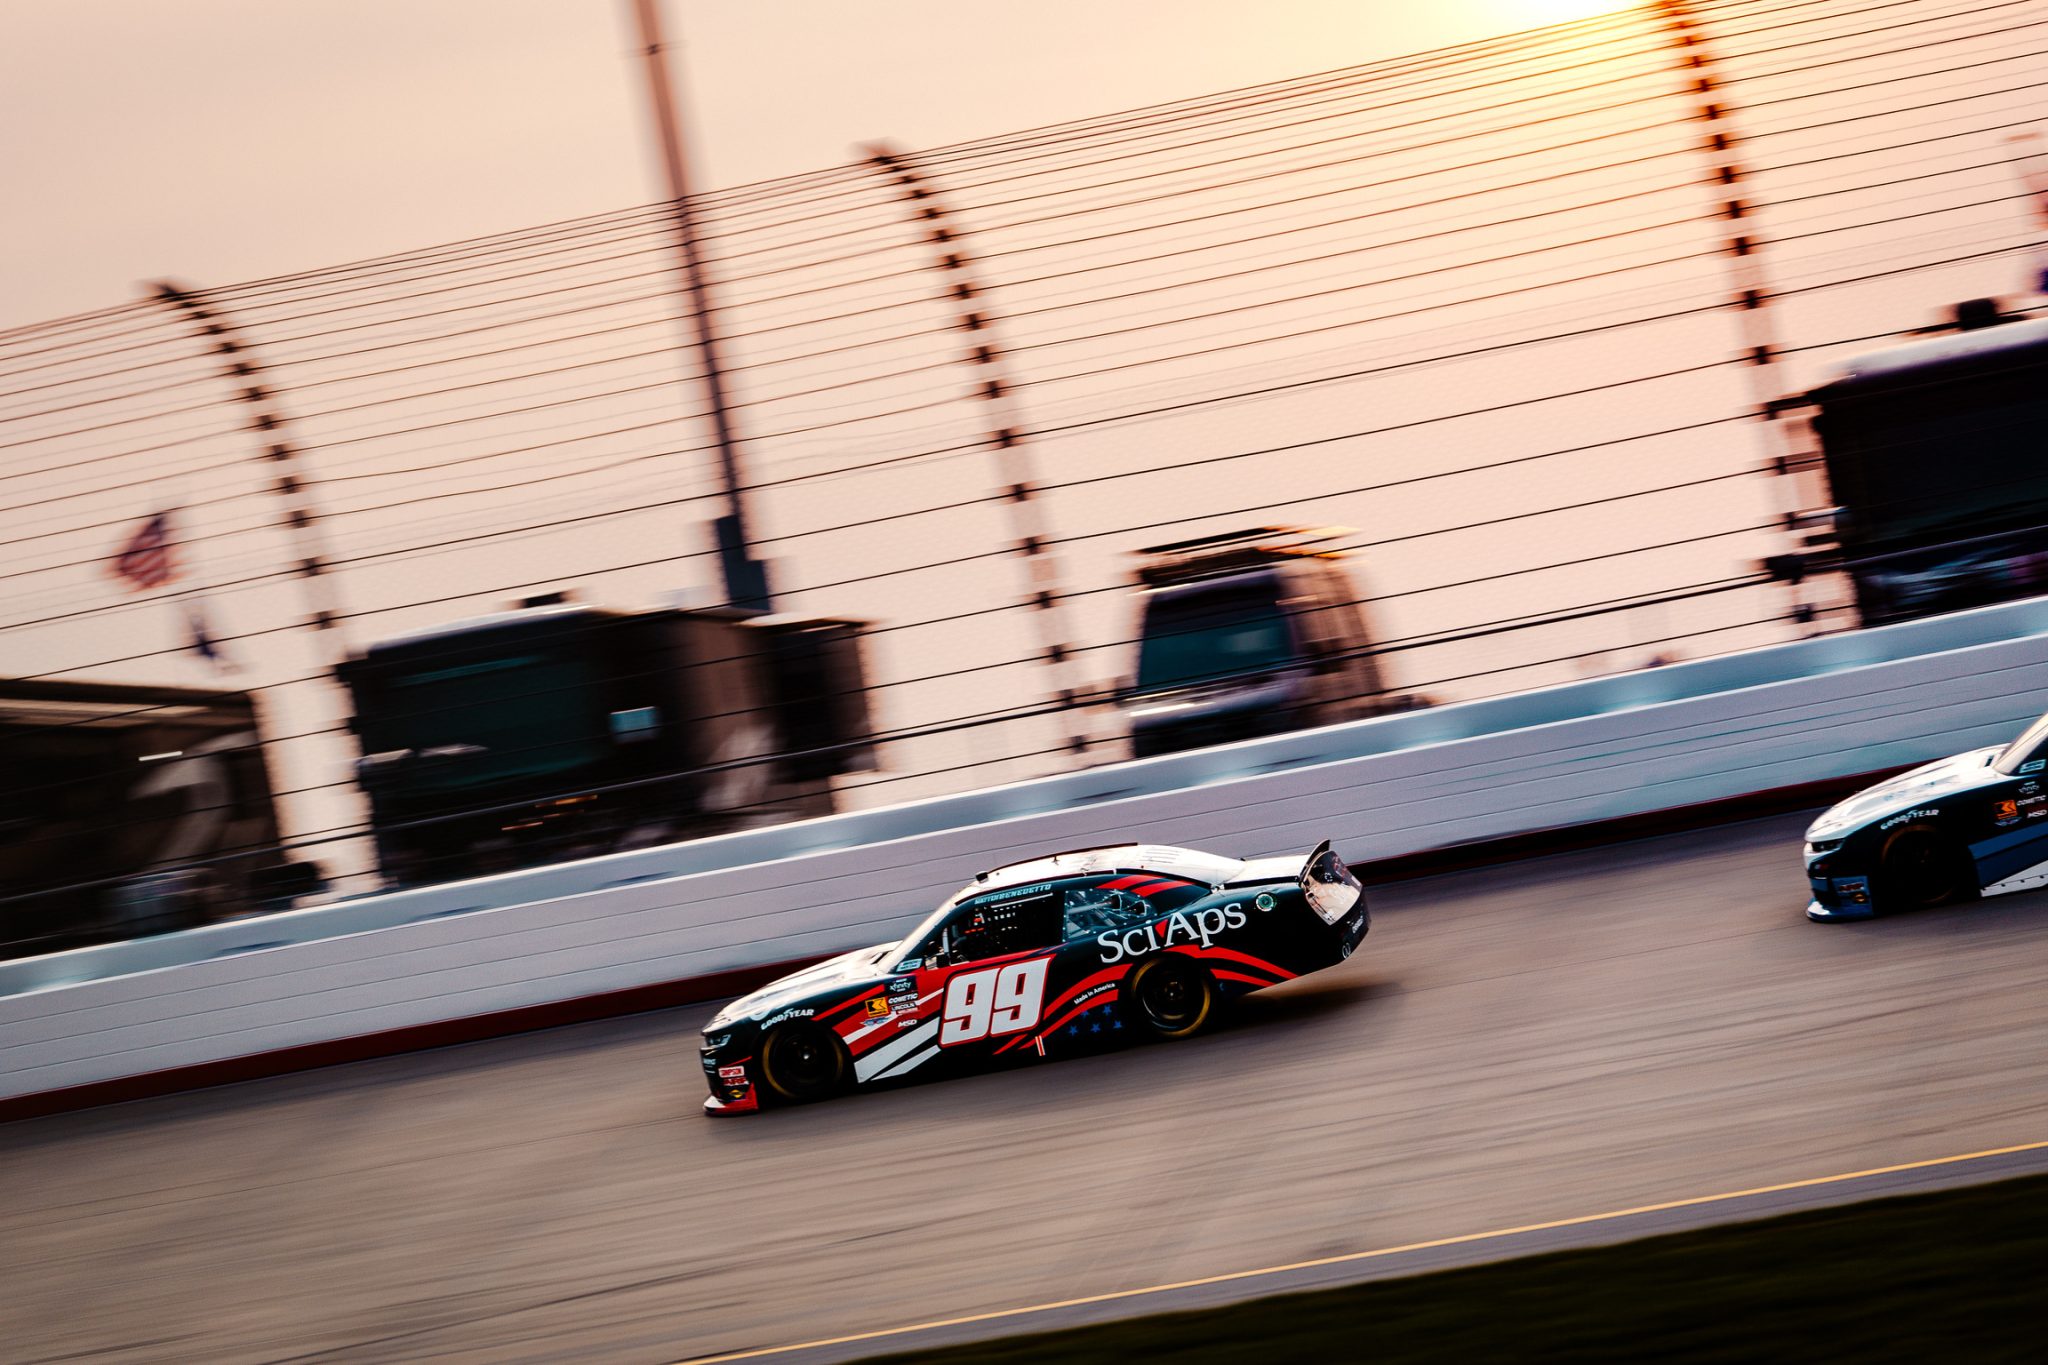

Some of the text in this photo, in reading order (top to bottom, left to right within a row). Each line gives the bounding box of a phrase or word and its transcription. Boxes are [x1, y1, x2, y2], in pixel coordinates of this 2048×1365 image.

[1880, 809, 1940, 830] GOODYEAR
[1097, 902, 1247, 964] SciAps
[888, 993, 919, 1004] COMETIC
[940, 957, 1052, 1046] 99
[760, 1008, 815, 1030] GOODYEAR
[897, 1019, 918, 1028] MSD
